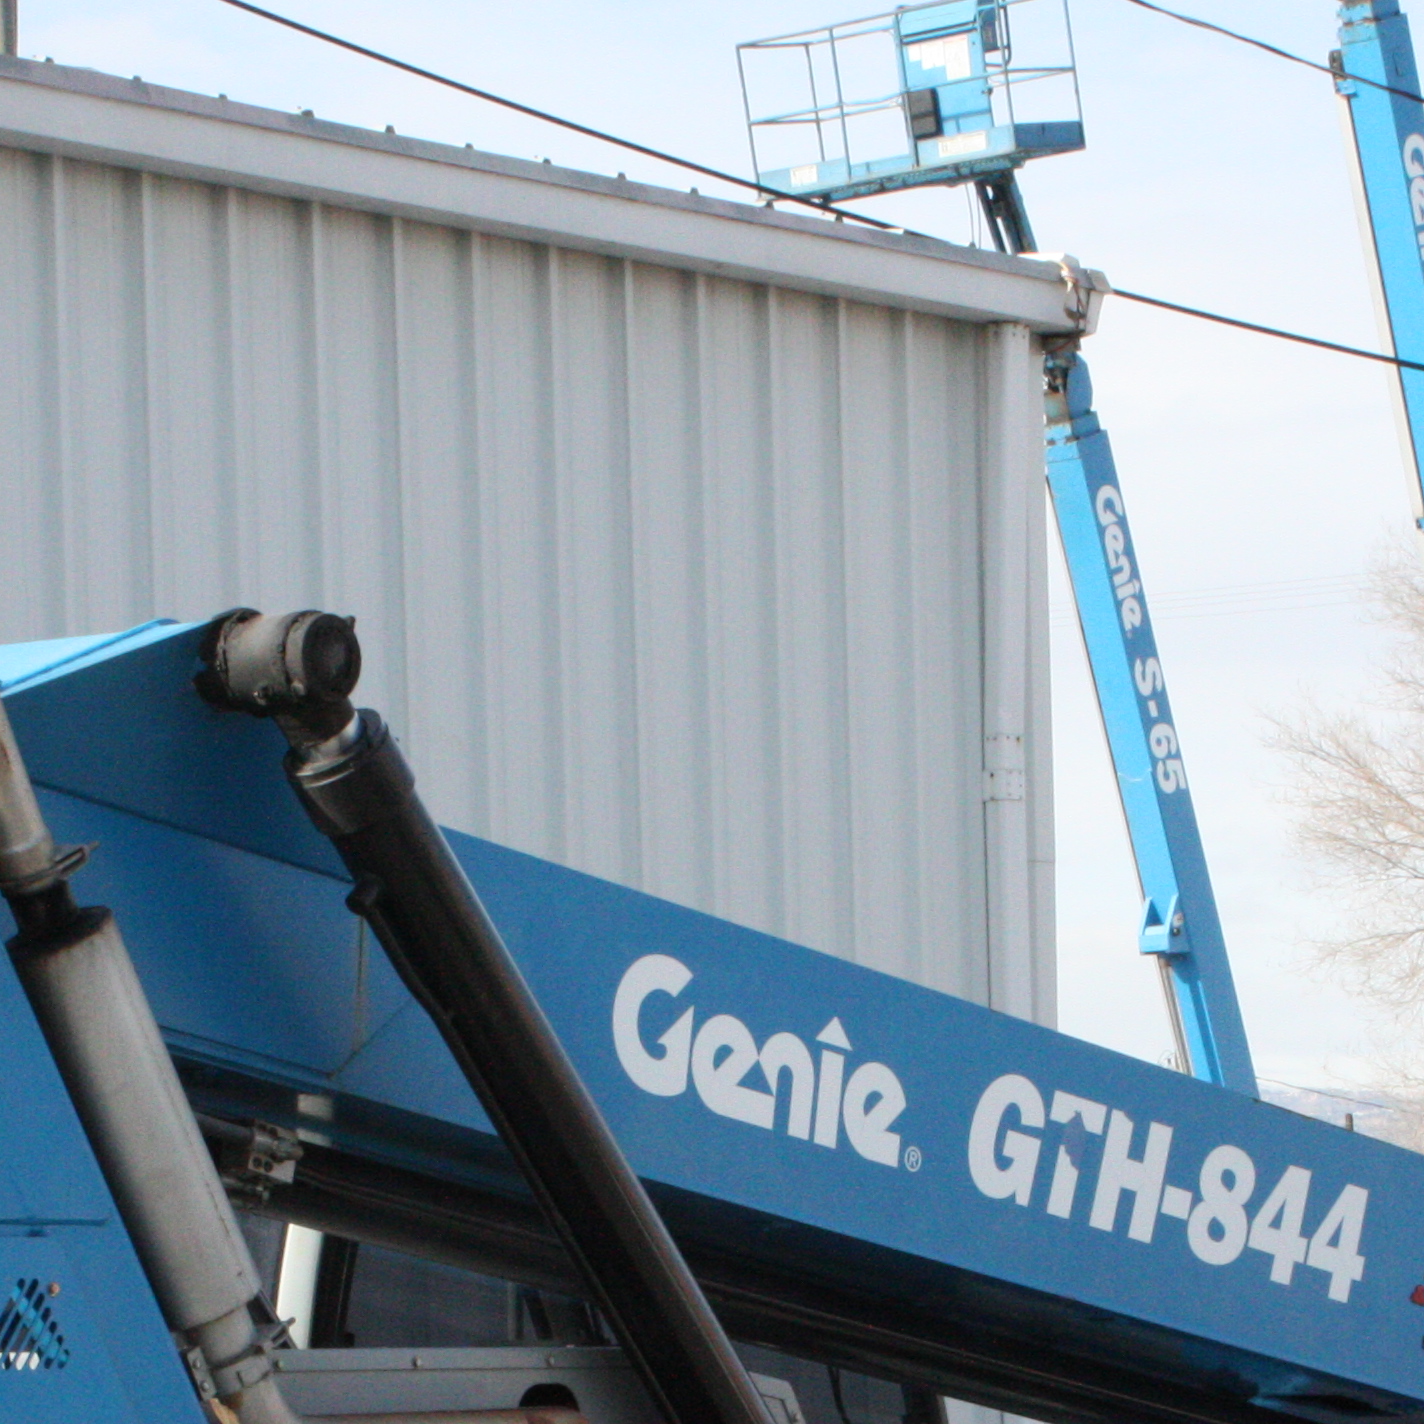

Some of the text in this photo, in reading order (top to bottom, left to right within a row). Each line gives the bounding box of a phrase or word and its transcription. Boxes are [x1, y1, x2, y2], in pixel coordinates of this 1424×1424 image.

[1096, 484, 1187, 794] Genie S-65
[612, 953, 1369, 1304] Genie GTH-844
